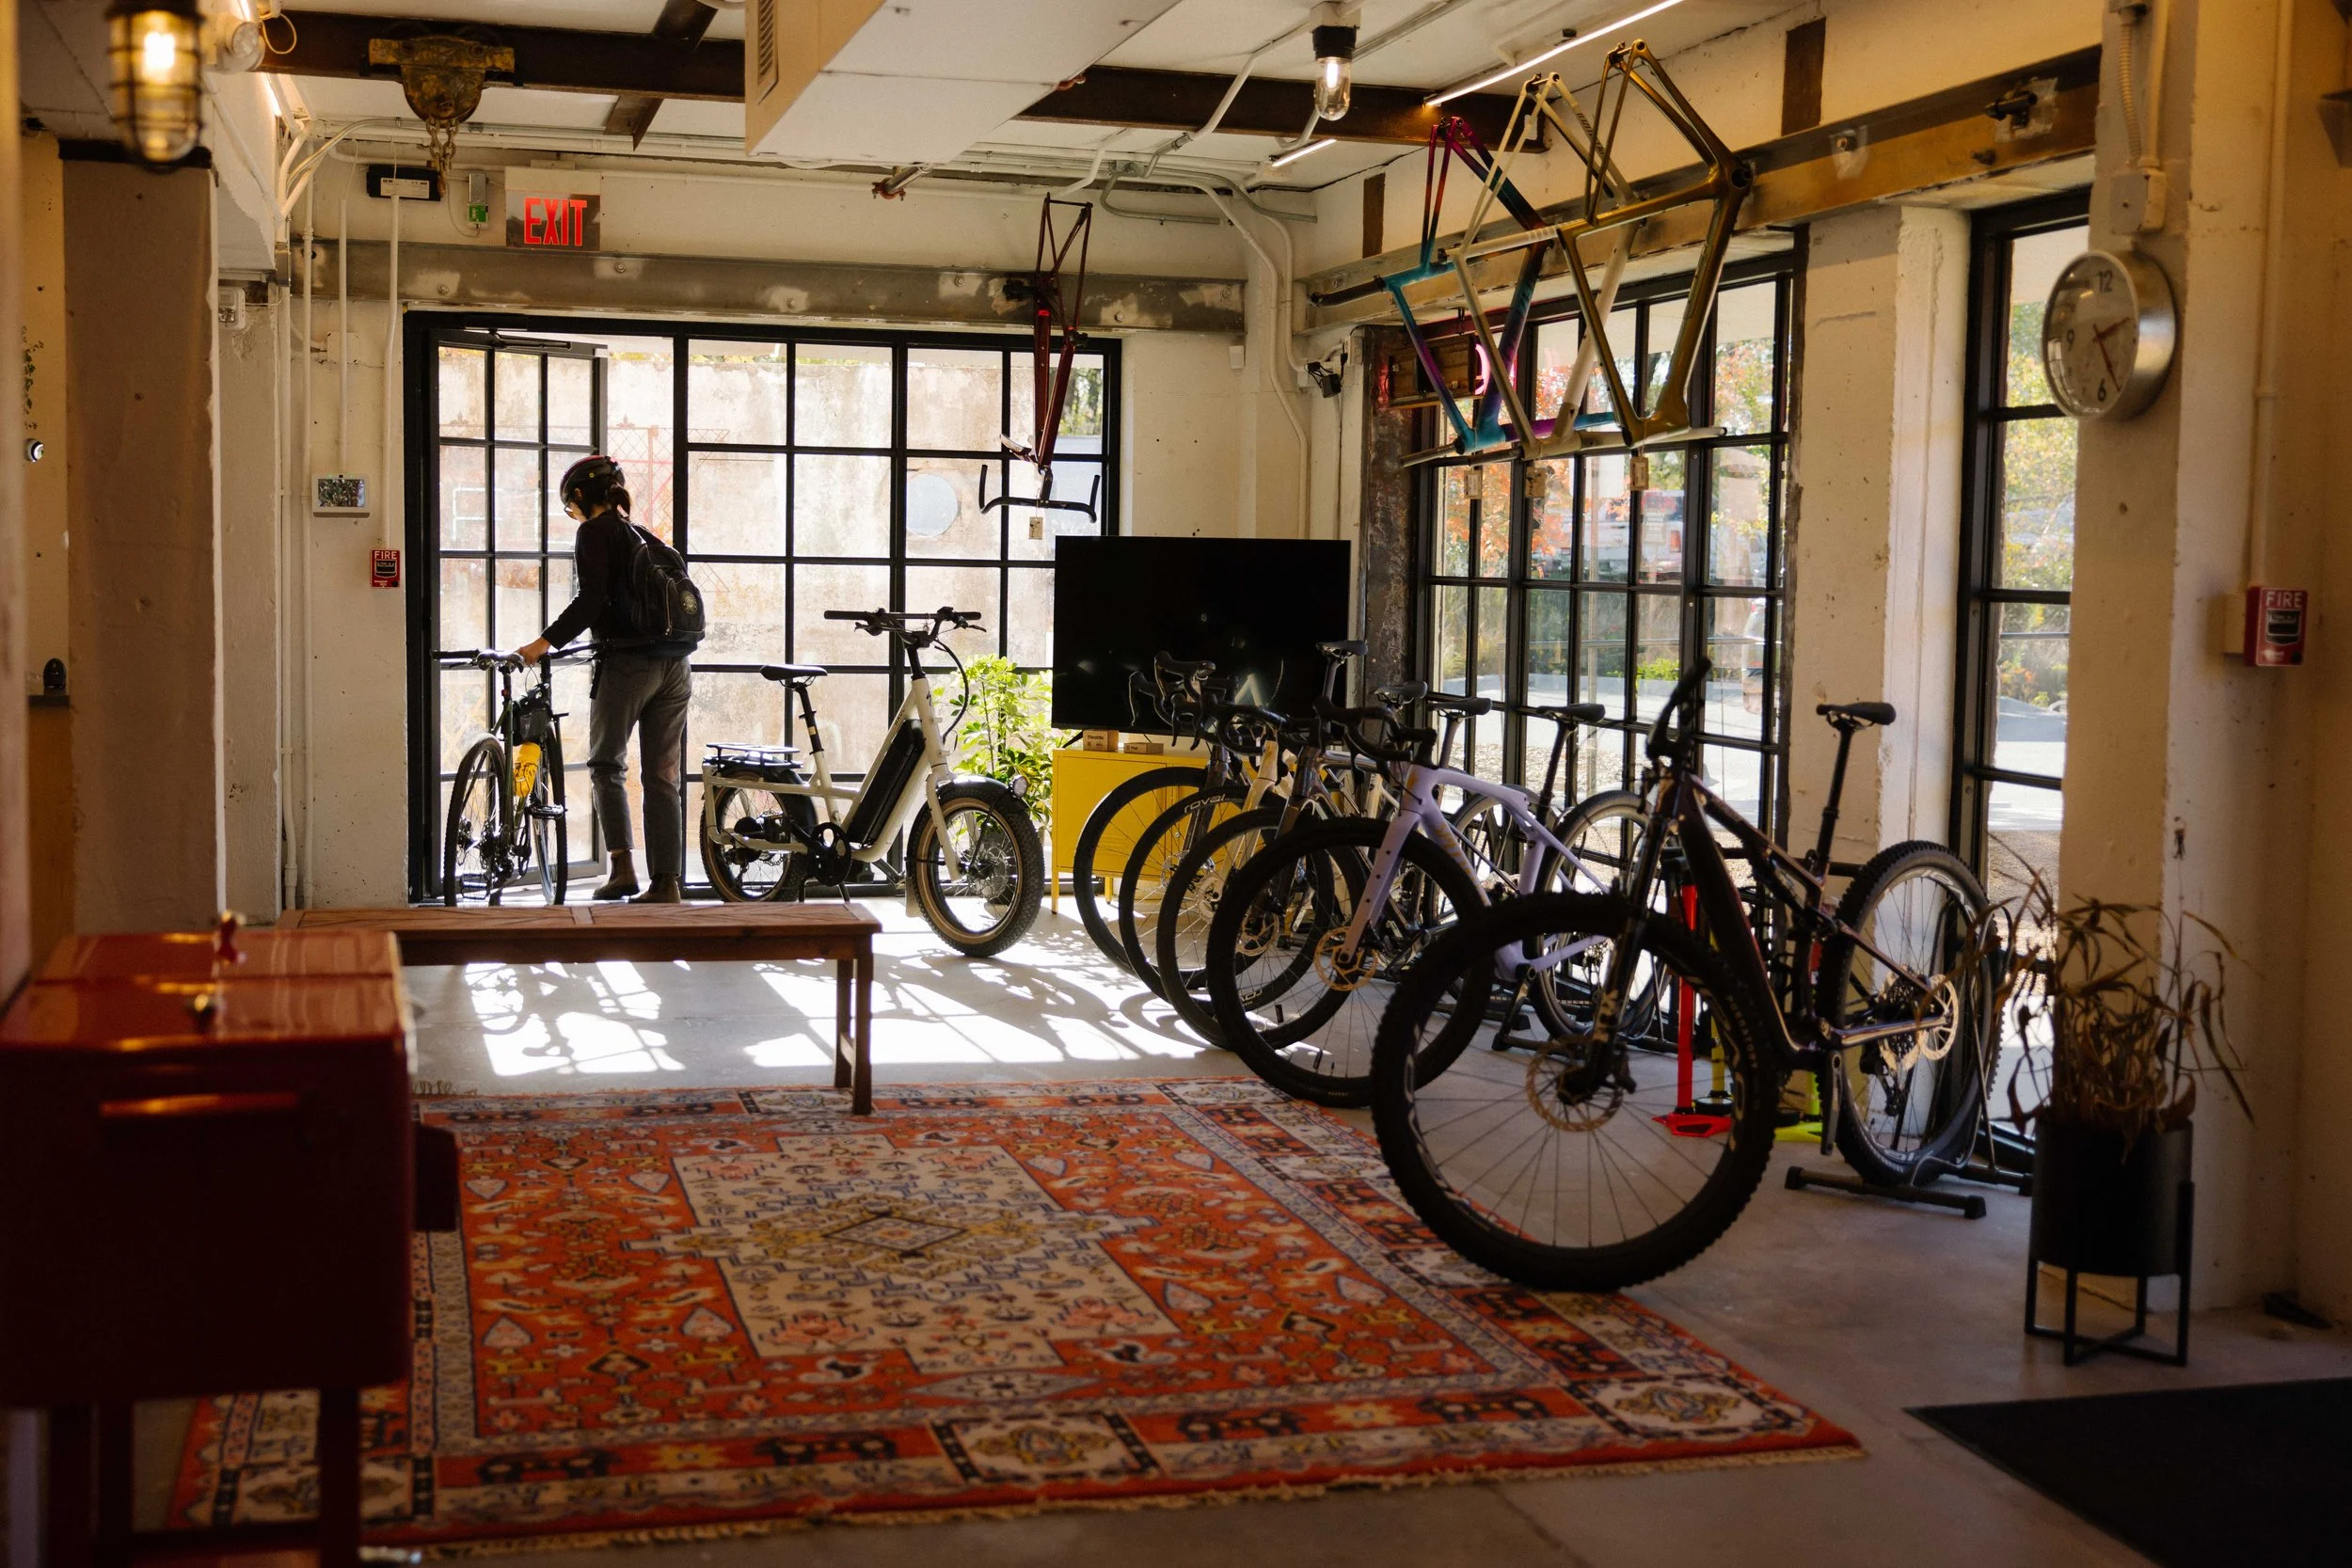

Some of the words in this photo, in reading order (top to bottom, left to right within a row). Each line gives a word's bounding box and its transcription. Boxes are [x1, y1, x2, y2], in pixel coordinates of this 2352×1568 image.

[524, 197, 588, 246] EXIT
[2098, 269, 2113, 293] 12
[2098, 378, 2106, 402] 6
[374, 550, 397, 560] FIRE
[2265, 591, 2303, 608] FIRE
